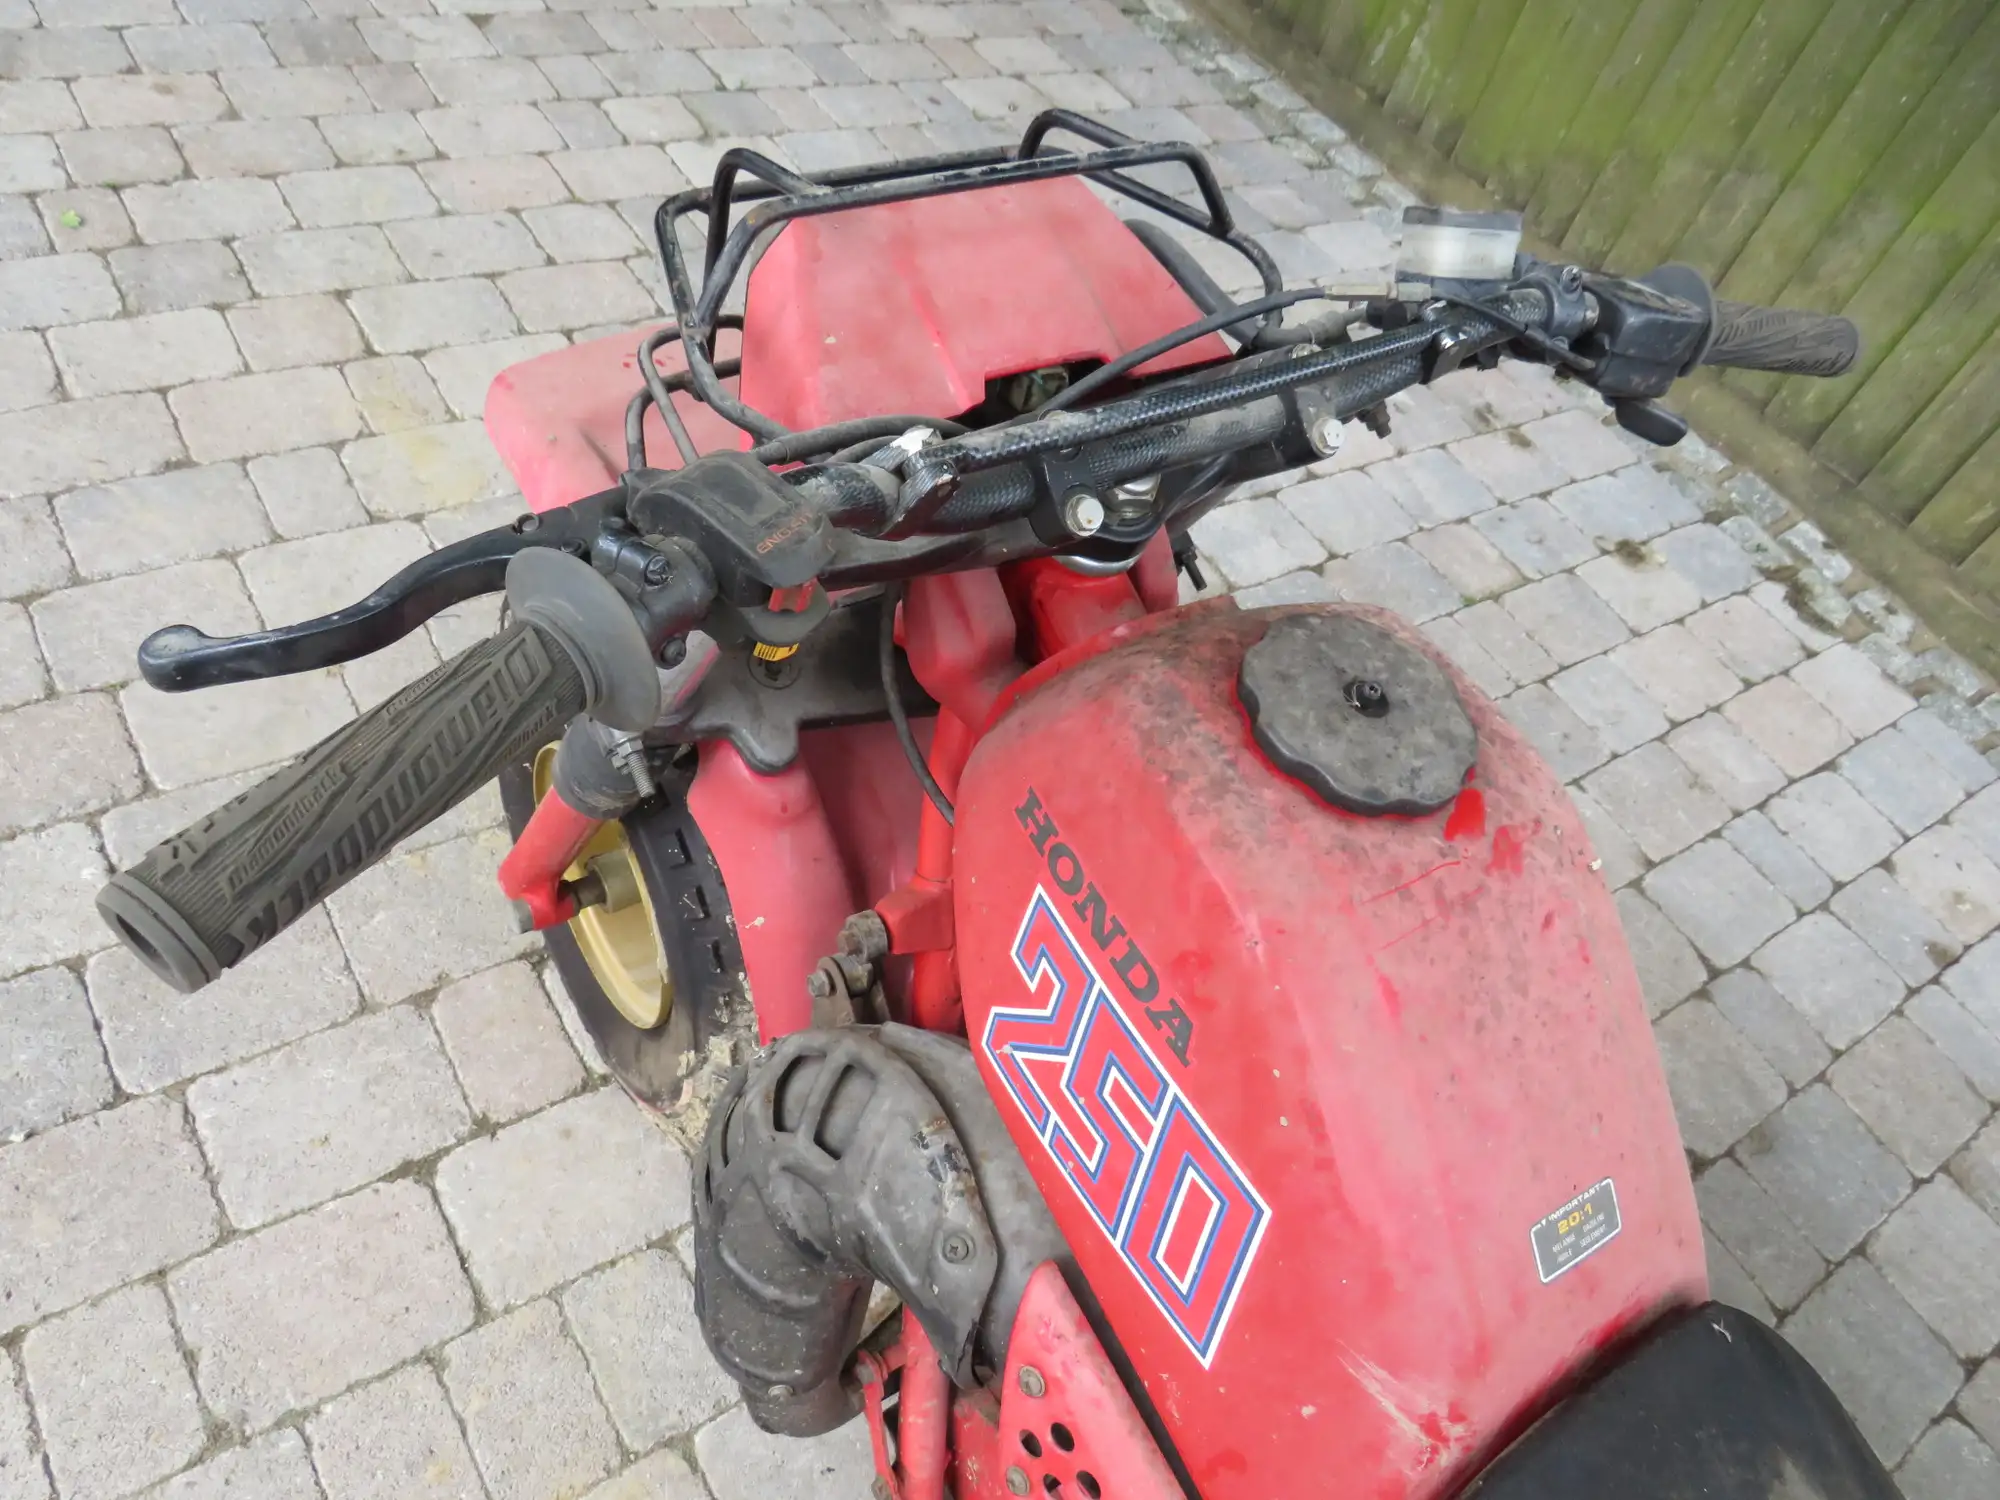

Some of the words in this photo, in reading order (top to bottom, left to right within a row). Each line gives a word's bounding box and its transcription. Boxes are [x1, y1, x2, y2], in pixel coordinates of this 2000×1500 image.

[227, 763, 343, 893] Diamondback
[1014, 785, 1197, 1068] HONDA
[981, 882, 1273, 1370] 250
[1548, 1183, 1601, 1222] IMPORTANT
[1557, 1202, 1593, 1235] 20:1
